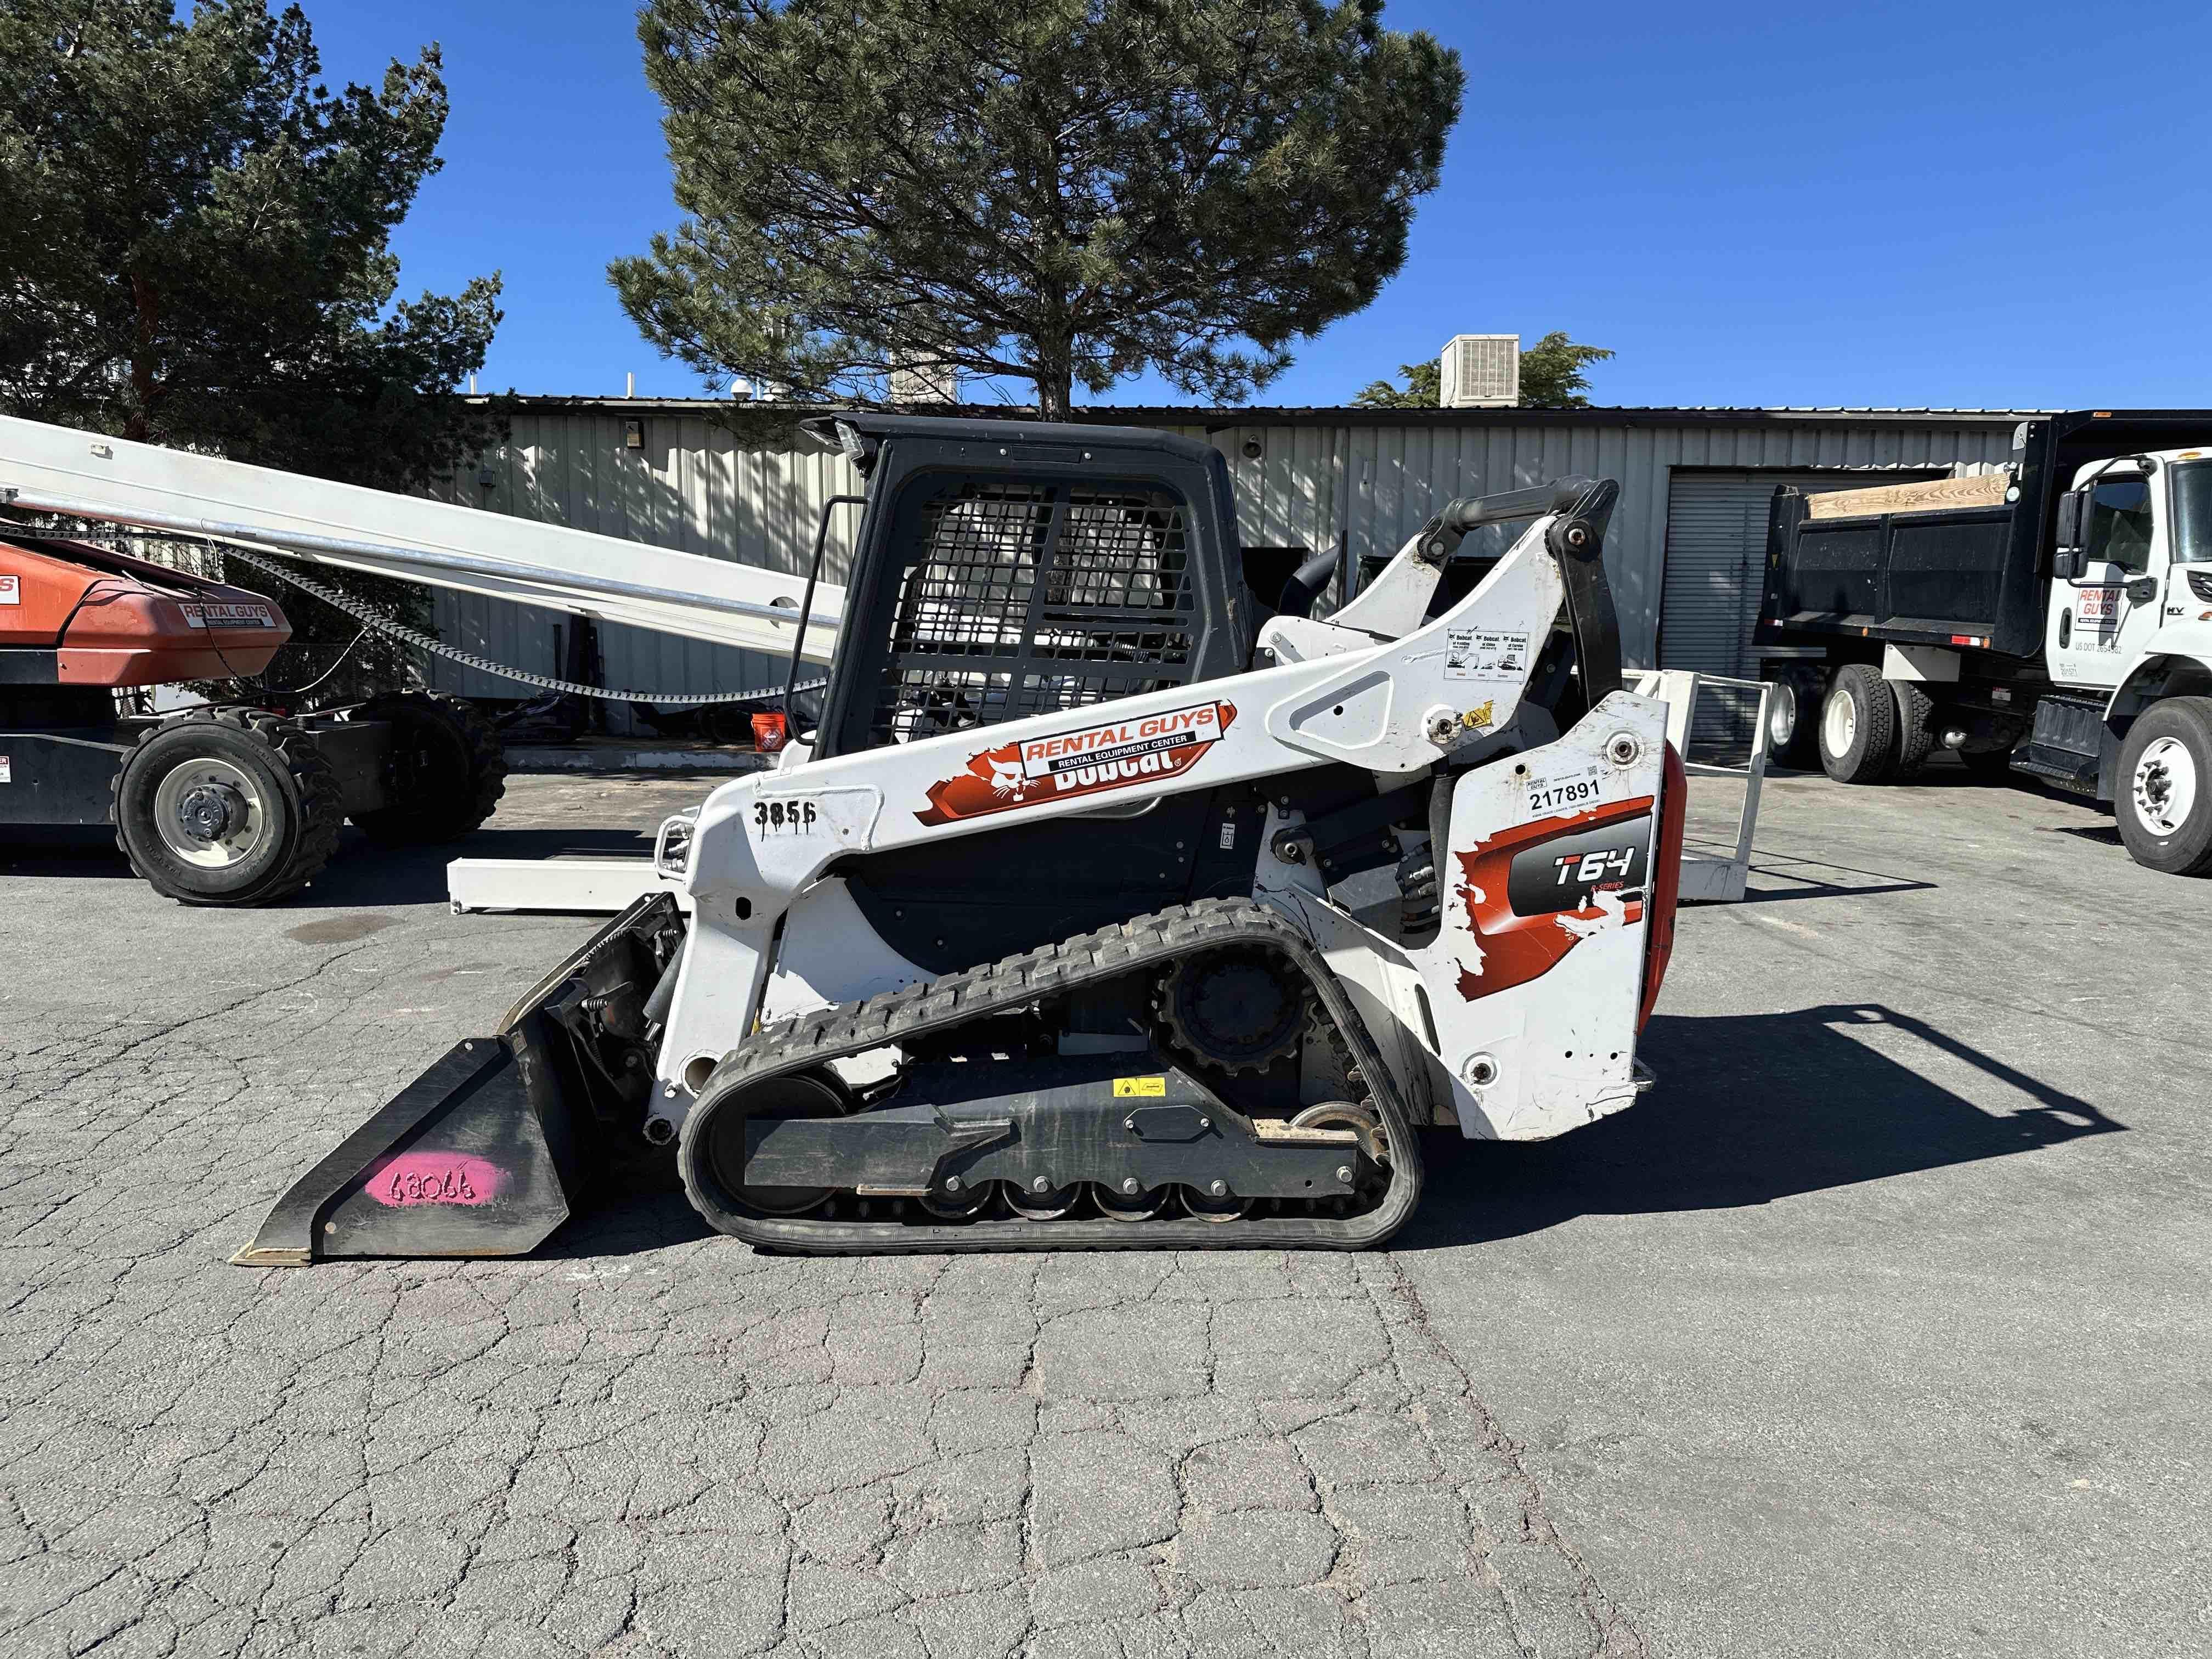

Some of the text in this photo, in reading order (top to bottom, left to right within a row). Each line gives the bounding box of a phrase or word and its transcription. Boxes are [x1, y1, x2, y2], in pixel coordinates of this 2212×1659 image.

[2080, 589, 2121, 602] RENTAL
[184, 605, 268, 617] RENTAL GUYS
[2084, 603, 2113, 615] GUYS
[2084, 642, 2095, 651] DOT
[1026, 708, 1214, 761] RENTAL GUYS
[1058, 735, 1188, 769] RENTAL EQUIPMENT CENTER
[1527, 778, 1545, 786] RENTAL
[1530, 779, 1599, 810] 217891
[1554, 847, 1635, 885] T64
[1590, 881, 1625, 891] R-SERIES
